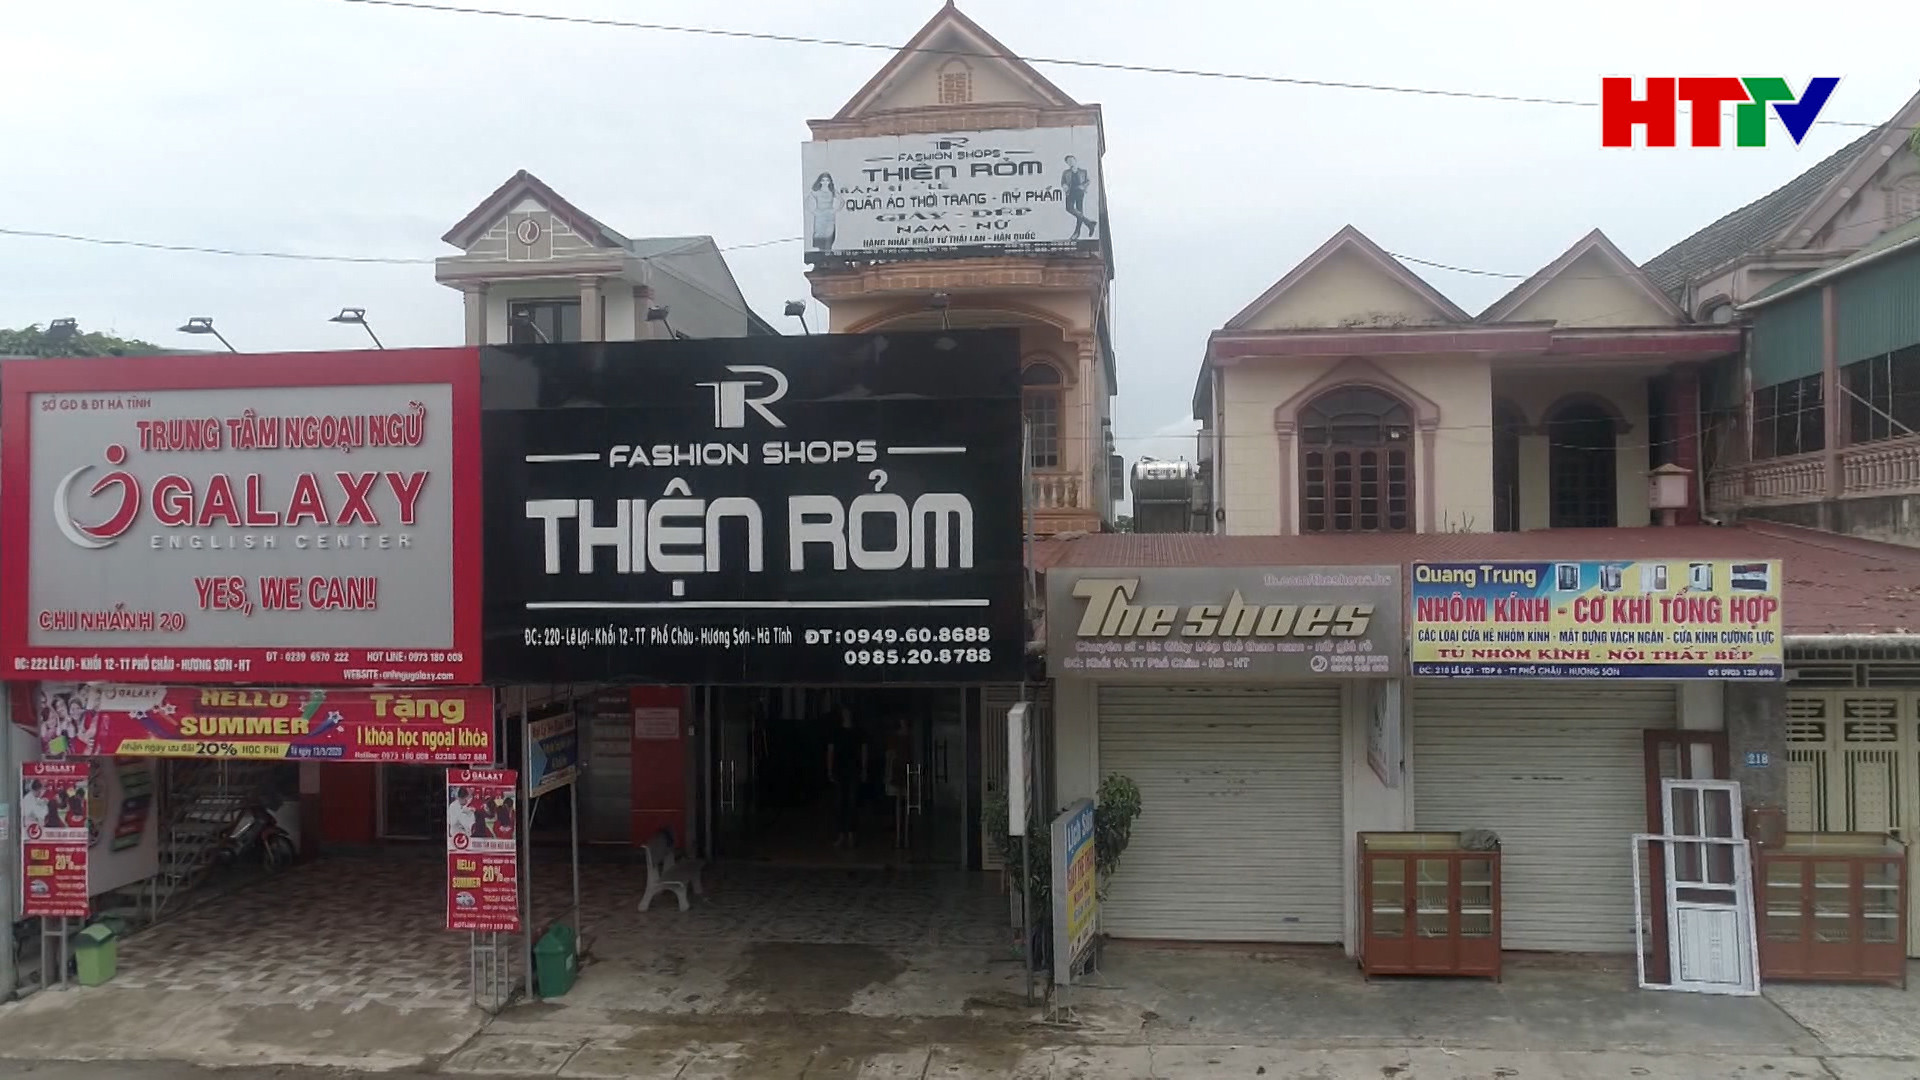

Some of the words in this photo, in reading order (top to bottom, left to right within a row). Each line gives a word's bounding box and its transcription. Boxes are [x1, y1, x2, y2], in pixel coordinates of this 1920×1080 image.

[957, 149, 1001, 160] SHOPS
[942, 192, 986, 207] TRANG
[897, 224, 950, 234] NAM
[60, 399, 78, 411] GD
[82, 399, 89, 410] &
[136, 419, 220, 451] TRUNG
[226, 407, 279, 450] TÂM
[284, 414, 364, 454] NGOẠI
[609, 443, 748, 468] FASHION
[762, 440, 878, 465] SHOPS
[150, 470, 430, 527] GALAXY
[150, 534, 277, 550] ENGLISH
[295, 533, 413, 549] CENTER
[1416, 566, 1476, 587] Quang
[1479, 565, 1537, 587] Trung
[193, 576, 252, 617] YES,
[259, 575, 303, 609] WE
[307, 575, 378, 610] CAN!
[1072, 577, 1179, 637] The
[1180, 587, 1375, 637] shoes
[1417, 591, 1486, 623] NHÔM
[1494, 591, 1549, 623] KÍNH
[1574, 594, 1608, 624] CƠ
[1612, 592, 1653, 624] KHÍ
[159, 611, 187, 633] 20
[544, 627, 560, 646] 220
[618, 627, 628, 646] 12
[635, 627, 646, 646] TT
[333, 652, 349, 662] 222
[367, 651, 384, 662] HOT
[844, 648, 991, 665] 0985.20.8788
[1471, 647, 1531, 659] NHÔM
[1537, 647, 1590, 660] KÍNH
[31, 657, 48, 670] 222
[104, 657, 115, 670] 12
[238, 659, 251, 671] HT
[1131, 658, 1146, 668] TT
[1234, 658, 1249, 668] HT
[370, 693, 465, 724] Tặng
[180, 717, 309, 736] SUMMER
[397, 727, 419, 750] học
[195, 742, 237, 755] 20%
[1748, 753, 1768, 764] 218
[471, 771, 504, 782] GALAXY
